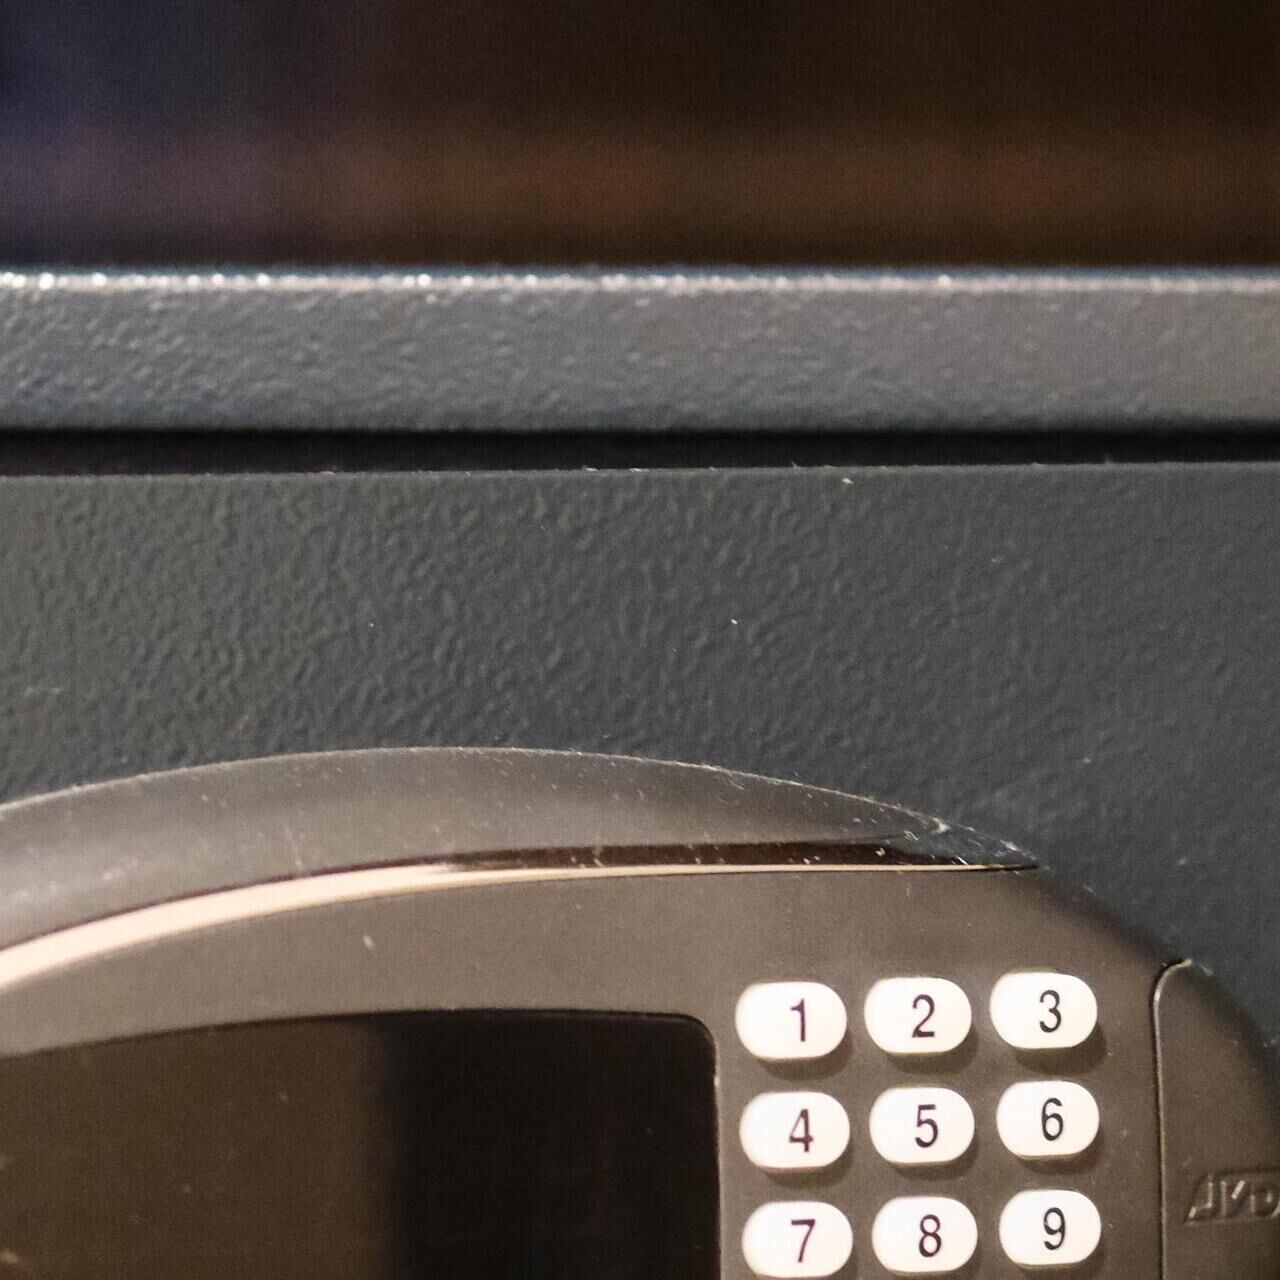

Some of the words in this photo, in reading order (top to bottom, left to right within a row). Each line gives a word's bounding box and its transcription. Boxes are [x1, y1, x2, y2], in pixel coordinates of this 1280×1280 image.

[791, 998, 807, 1042] 1
[911, 993, 936, 1038] 2
[1037, 988, 1062, 1033] 3
[787, 1107, 814, 1153] 4
[914, 1103, 939, 1148] 5
[1040, 1097, 1064, 1141] 6
[791, 1218, 816, 1264] 7
[918, 1213, 943, 1258] 8
[1042, 1206, 1067, 1251] 9
